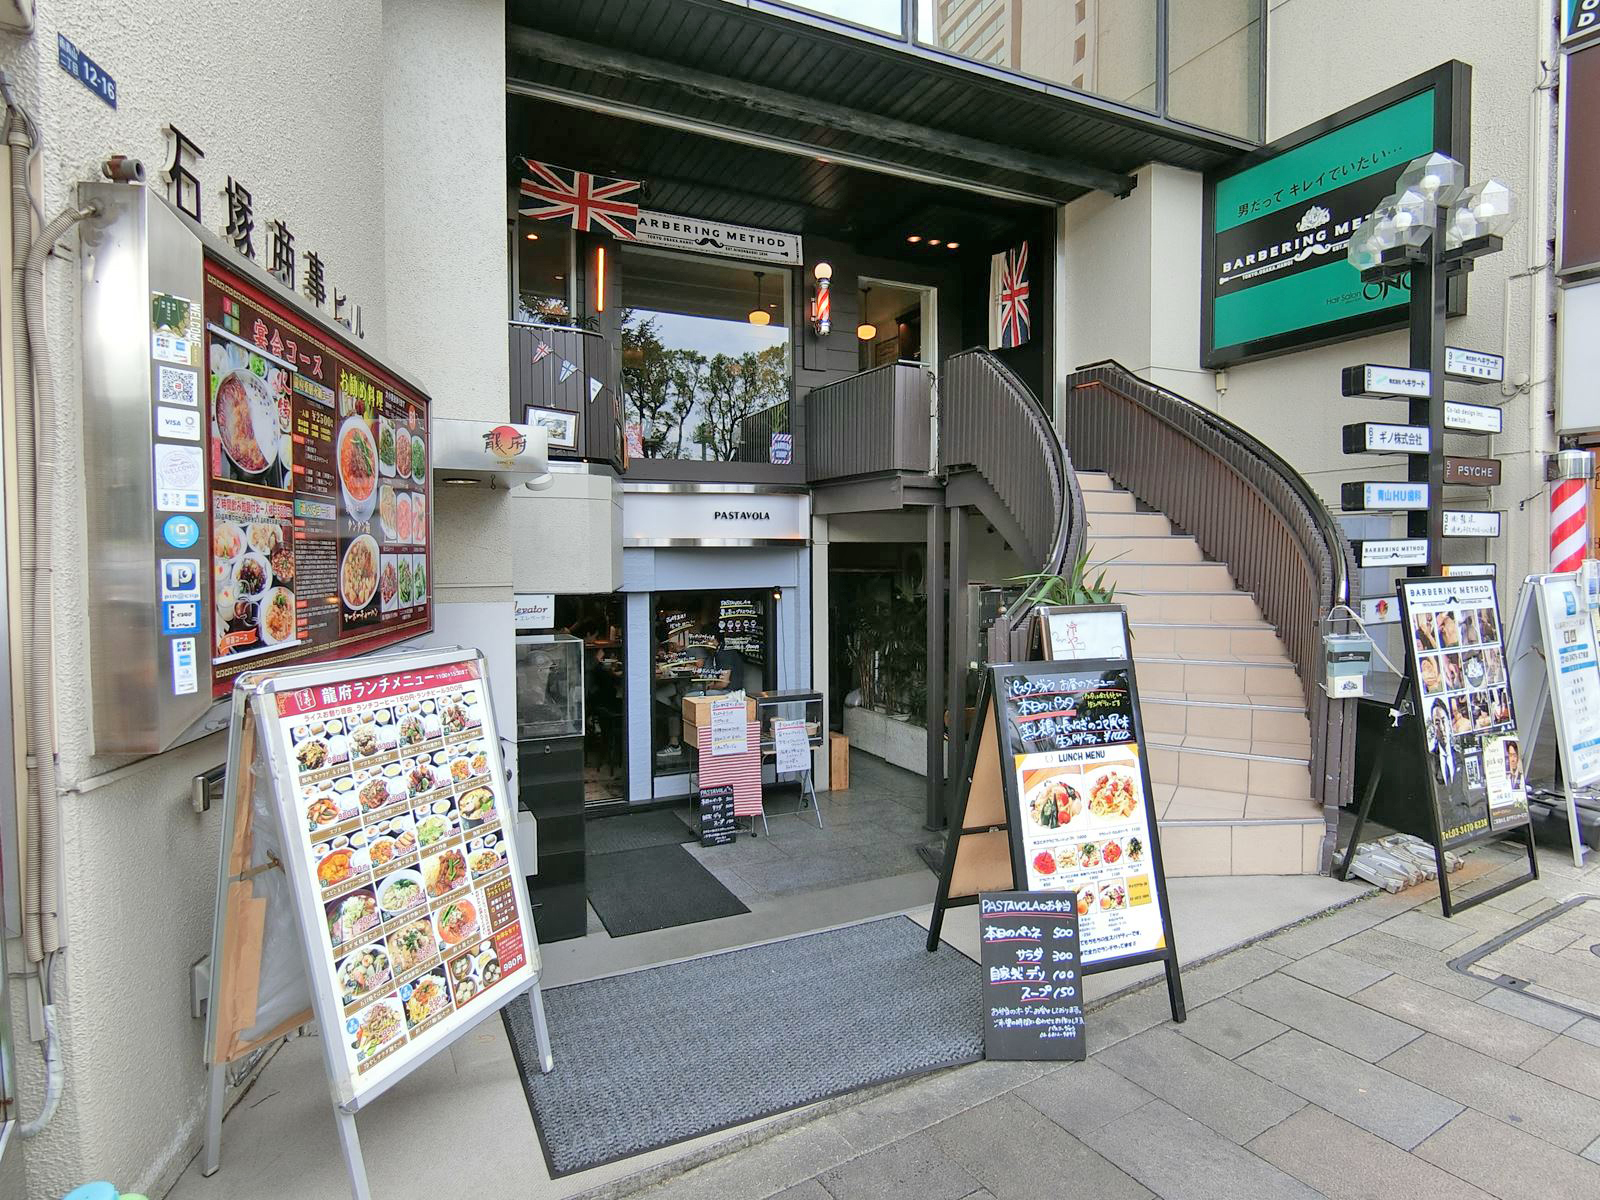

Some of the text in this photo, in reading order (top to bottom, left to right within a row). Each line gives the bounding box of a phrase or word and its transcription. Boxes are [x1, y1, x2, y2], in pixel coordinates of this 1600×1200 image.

[83, 61, 115, 100] 12-16
[1237, 188, 1285, 217] 男だって
[638, 216, 786, 248] ARBERING METHOD
[1222, 229, 1327, 273] BARBERING
[190, 303, 201, 347] WELCOME
[252, 316, 323, 380] 宴会コース
[339, 368, 384, 412] お勧め料理
[165, 418, 181, 426] VISA
[1379, 431, 1423, 446] ギノ株式会社
[1457, 466, 1493, 477] PSYCHE
[714, 511, 770, 520] PASTAVOLA
[1410, 585, 1489, 596] BARBERING METHOD
[515, 601, 548, 615] levator
[320, 674, 435, 704] 龍府ランチメニュー
[1018, 696, 1074, 716] 本日のパスタ
[1020, 713, 1130, 742] 蒸し鶏と長ねぎのゴマ風味
[1103, 729, 1130, 743] ¥1000
[1058, 750, 1106, 763] LUNCH MENU
[982, 899, 1071, 913] PASTAVOLAのお弁当
[983, 925, 1074, 941] 本日のペンネ 500
[1016, 947, 1073, 962] サラダ 300
[990, 966, 1074, 982] 自家製 デリ 100
[1021, 985, 1075, 1000] スープ 150
